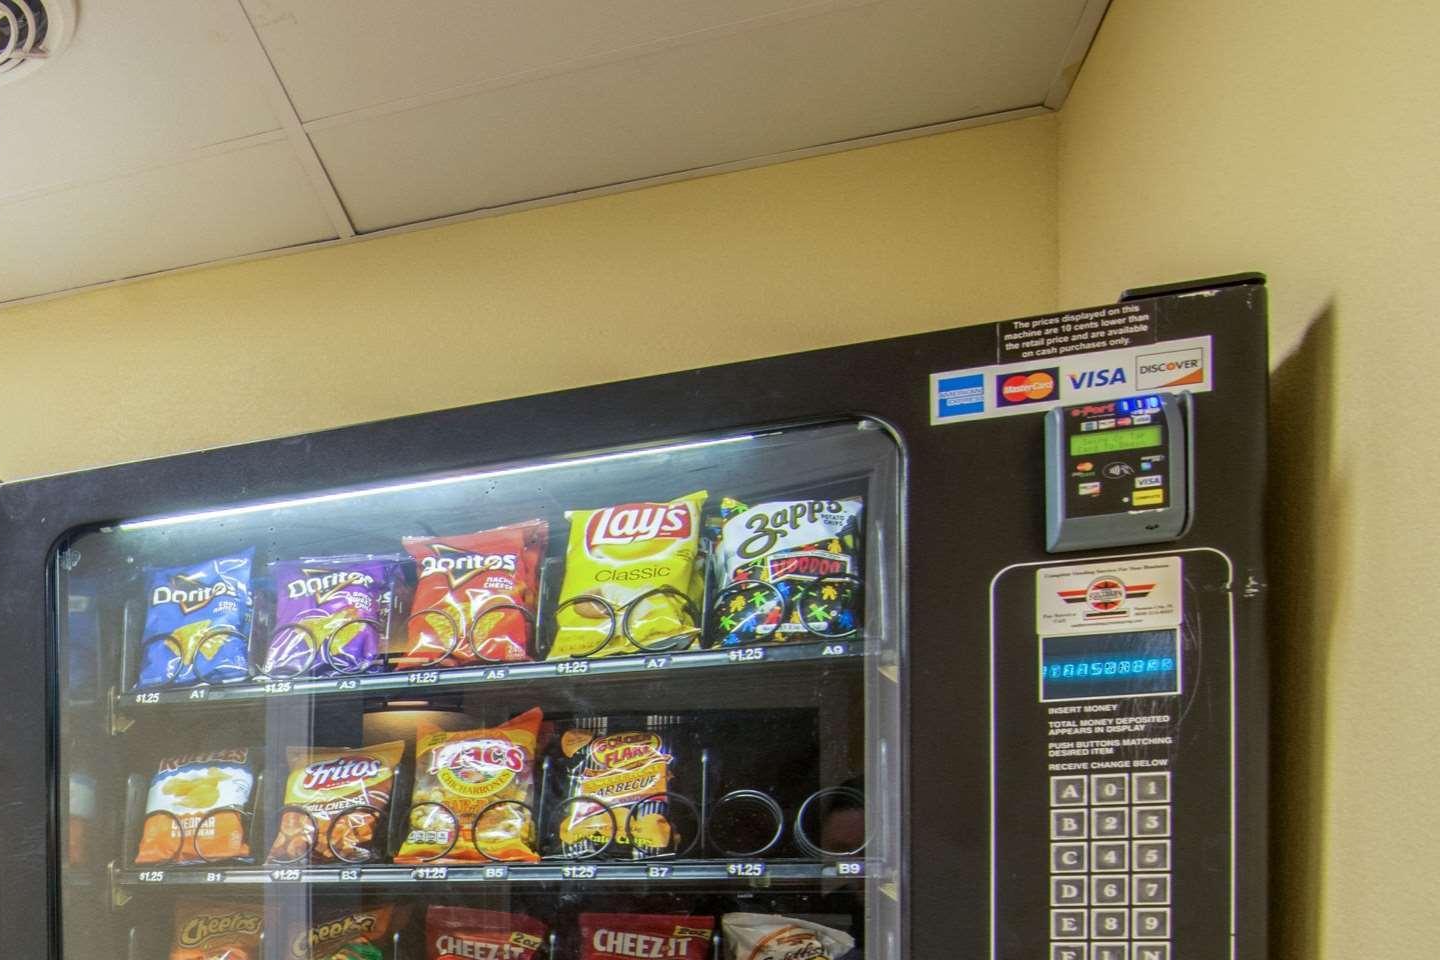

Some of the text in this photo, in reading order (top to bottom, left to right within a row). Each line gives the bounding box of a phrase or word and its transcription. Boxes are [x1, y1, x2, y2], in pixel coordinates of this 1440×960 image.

[1013, 321, 1030, 329] The
[1032, 317, 1059, 328] prices
[1061, 309, 1106, 323] displayed
[1122, 305, 1140, 313] this
[1004, 330, 1042, 340] machine
[1044, 327, 1059, 335] are
[1074, 321, 1099, 331] cents
[1101, 318, 1126, 327] lower
[1128, 314, 1150, 323] than
[1005, 324, 1148, 350] the retail price and are available
[1022, 350, 1035, 358] on
[1035, 347, 1058, 356] cash
[1059, 340, 1108, 354] purchases
[1139, 359, 1199, 375] DISCOVER
[1069, 367, 1127, 389] VISA
[1003, 379, 1055, 395] MasterCard
[594, 565, 671, 583] Classic
[287, 570, 374, 599] Doritos
[152, 582, 240, 605] Doritos
[729, 645, 844, 660] $1.25 A9
[558, 659, 666, 673] $1.25 A7
[409, 670, 505, 684] $1.25 A5
[136, 689, 206, 704] $1.25 A1
[1048, 704, 1118, 715] INSERT MONEY
[1048, 715, 1170, 729] TOTAL MONEY DEPOSITED
[1048, 727, 1093, 736] APPEARS
[1105, 724, 1146, 733] DISPLAY
[1048, 737, 1172, 750] PUSH BUTTONS MATCHING
[1048, 747, 1114, 757] DESIRED ITEM
[1048, 758, 1169, 771] RECEIVE CHANGE BELOW
[303, 759, 382, 790] Fritos
[139, 871, 221, 882] $1.25 B1
[417, 866, 504, 879] $1.25 B5
[563, 866, 668, 879] $1.25 B7
[727, 863, 861, 876] $1.25 B9
[180, 912, 259, 945] Cheetos
